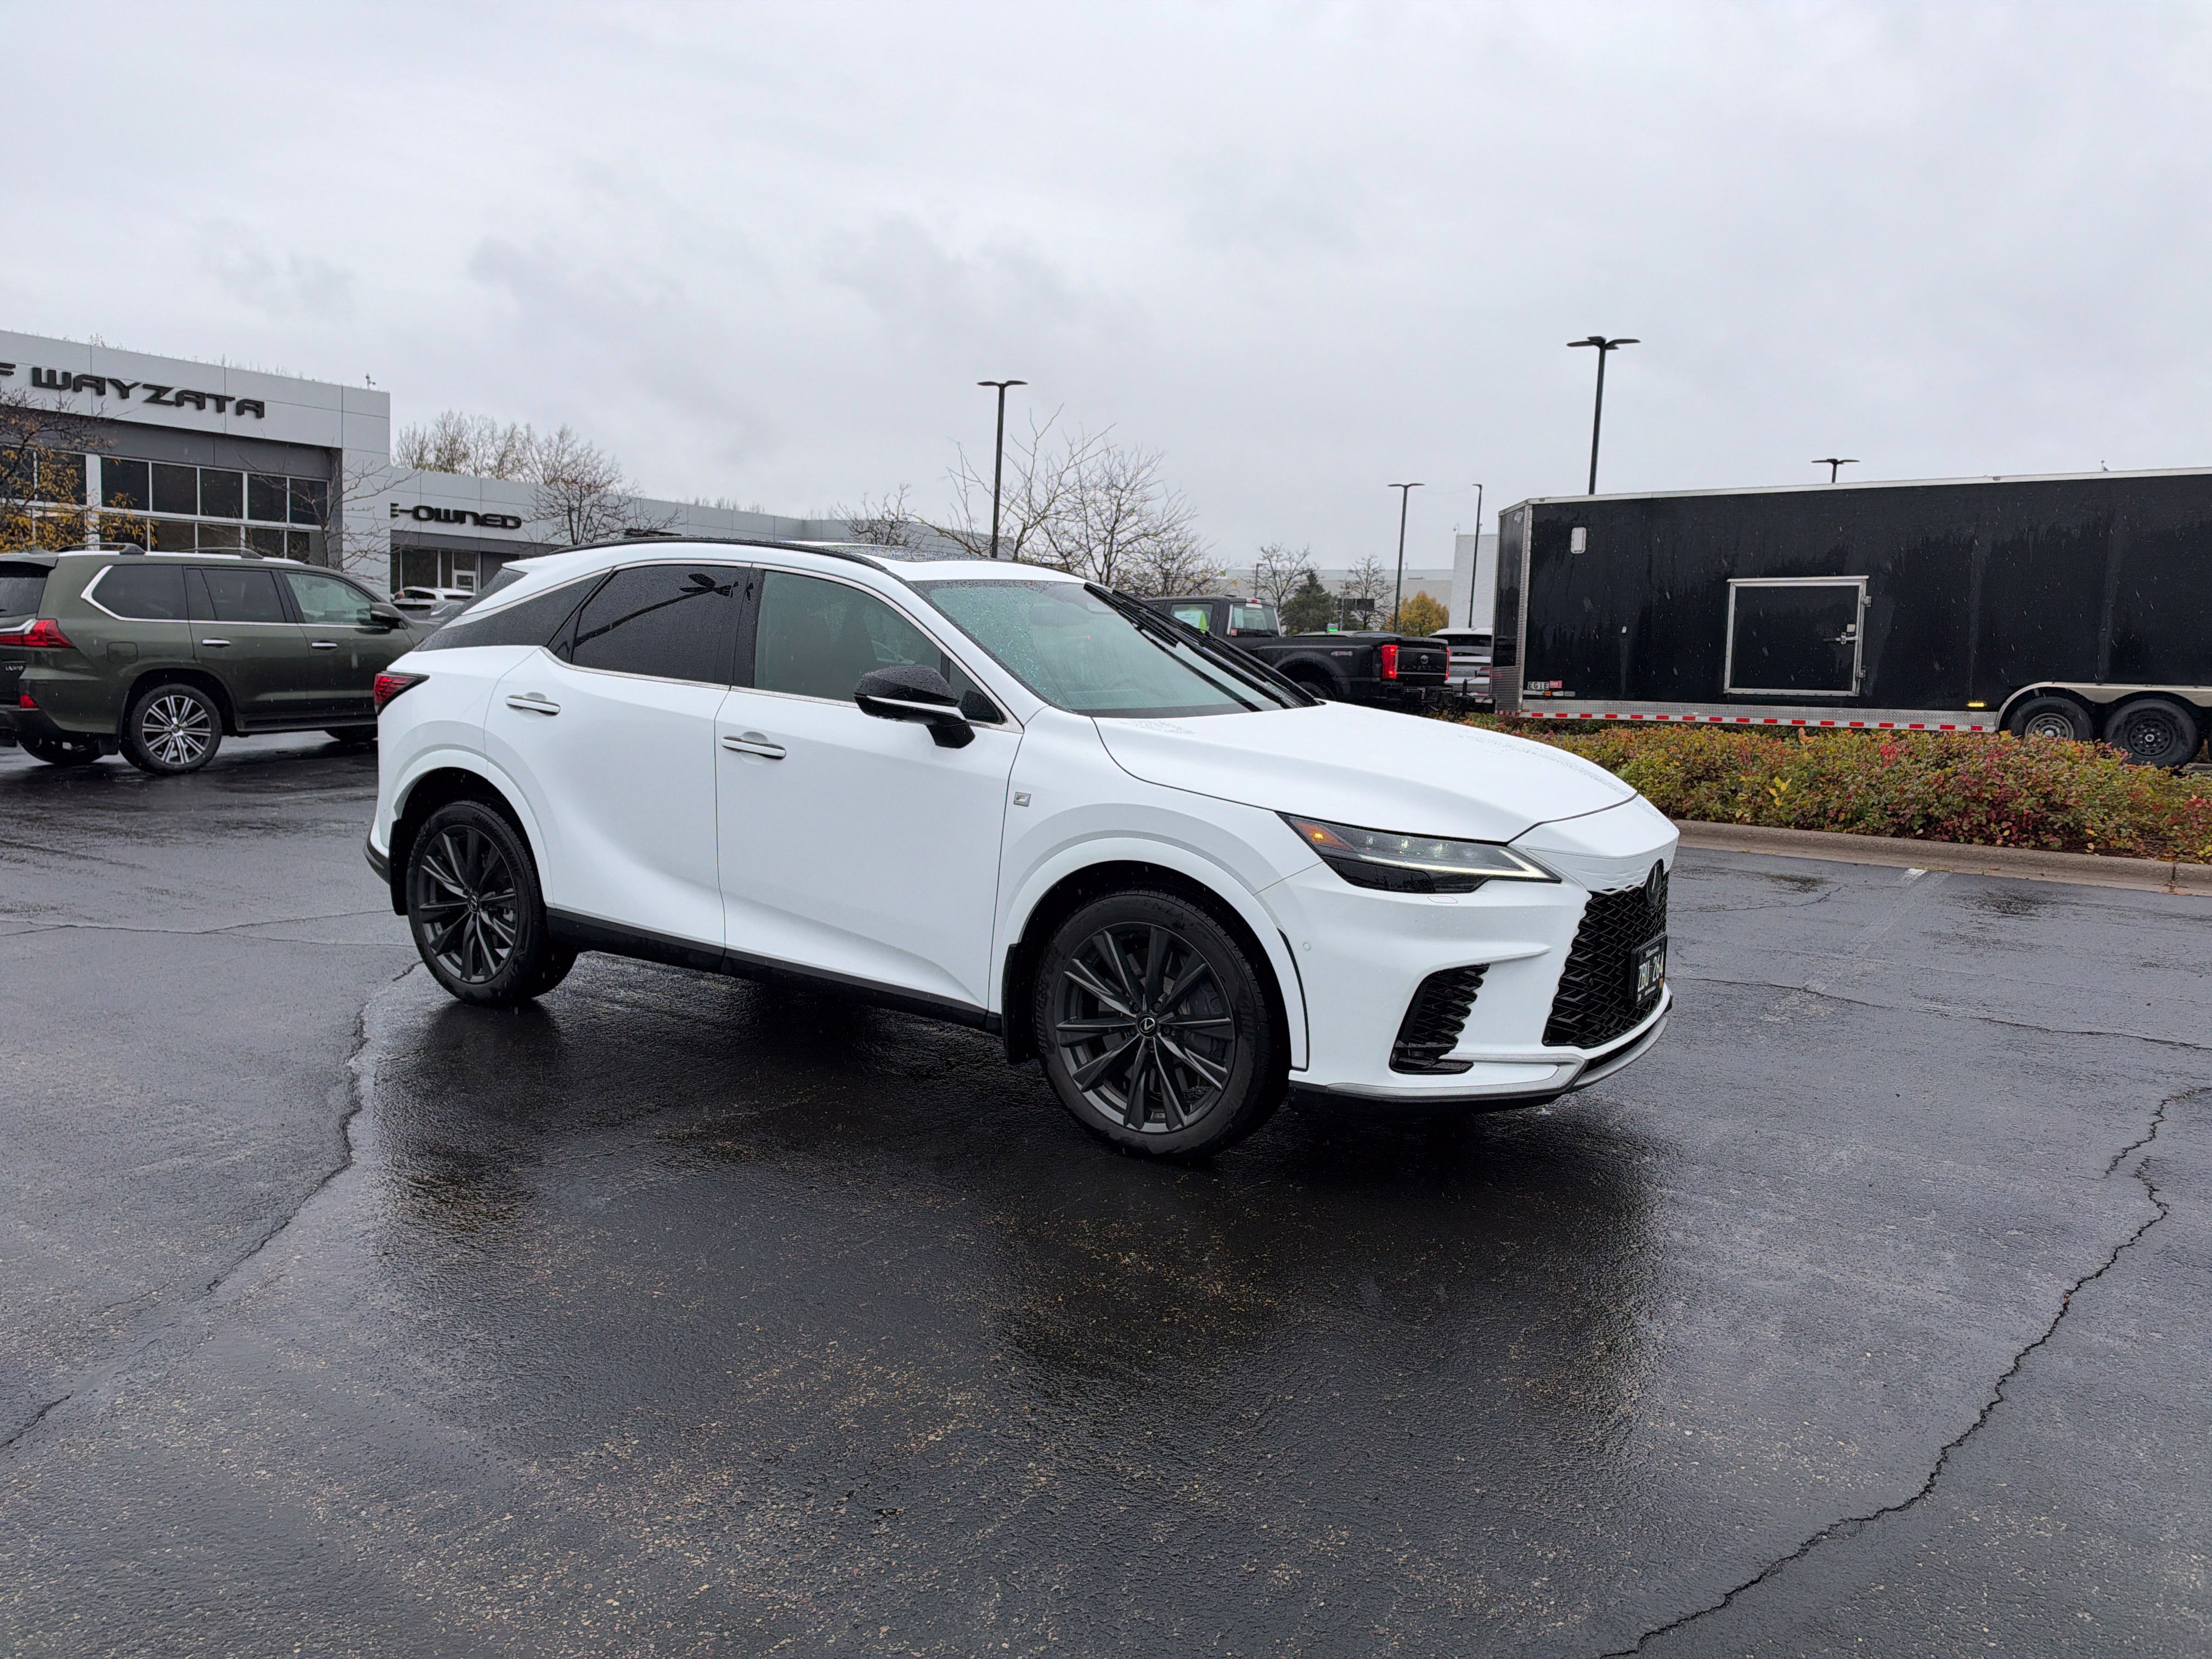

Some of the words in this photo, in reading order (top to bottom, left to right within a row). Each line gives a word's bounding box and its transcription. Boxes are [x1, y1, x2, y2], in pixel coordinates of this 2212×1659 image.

[31, 366, 265, 419] WAYZATA
[1638, 960, 1650, 993] ZBU
[1652, 951, 1664, 983] 264
